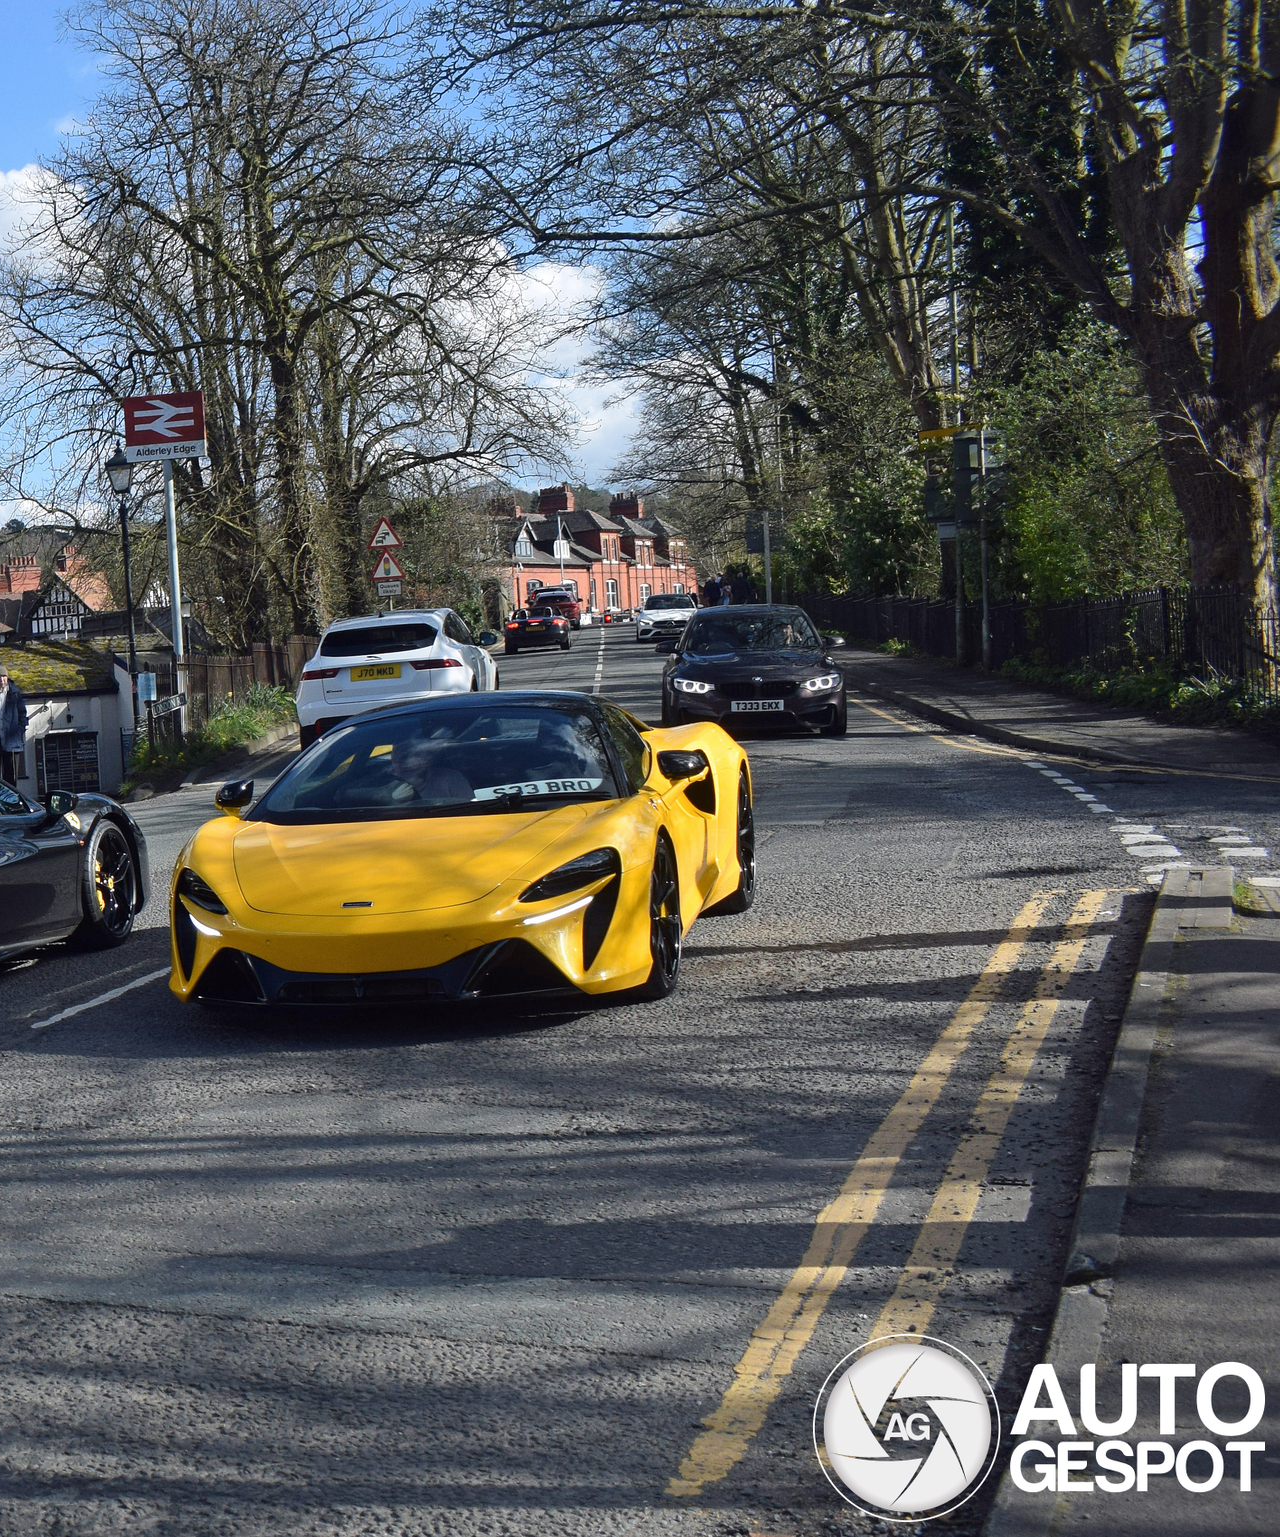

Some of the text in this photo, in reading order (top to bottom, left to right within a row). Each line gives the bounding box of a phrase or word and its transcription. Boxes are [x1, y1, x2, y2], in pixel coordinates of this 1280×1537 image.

[136, 444, 196, 456] Alderley Edge
[357, 666, 394, 678] J70 MKD
[153, 698, 176, 715] LONDON
[735, 701, 780, 710] T333 EKX
[545, 780, 592, 792] BRO
